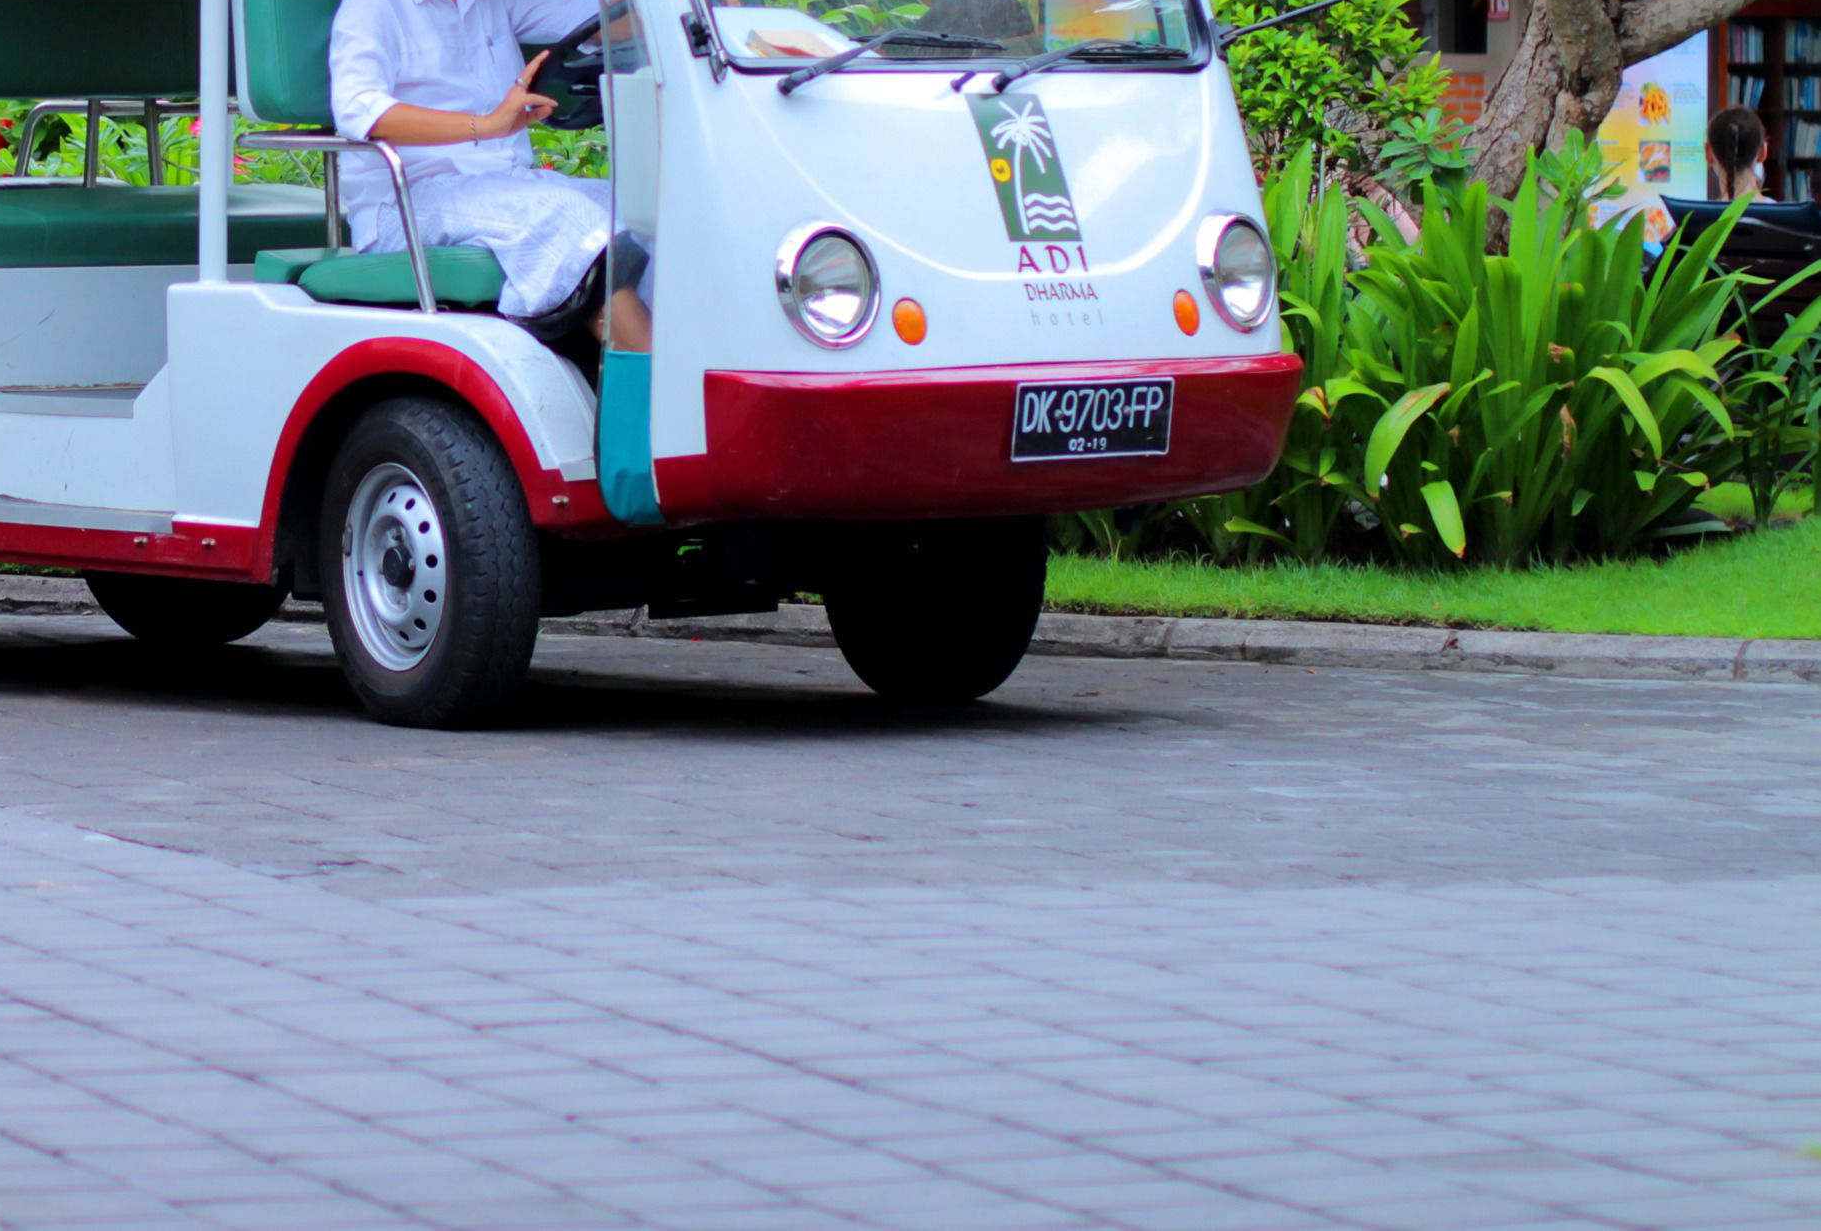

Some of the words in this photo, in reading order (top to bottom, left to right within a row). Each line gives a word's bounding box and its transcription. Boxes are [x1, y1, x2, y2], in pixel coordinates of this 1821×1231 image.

[1018, 244, 1089, 274] ADI
[1023, 282, 1099, 301] DHARMA
[1030, 308, 1104, 326] hotel
[1022, 390, 1057, 433] DK
[1059, 388, 1126, 433] 9703
[1128, 386, 1164, 428] FP
